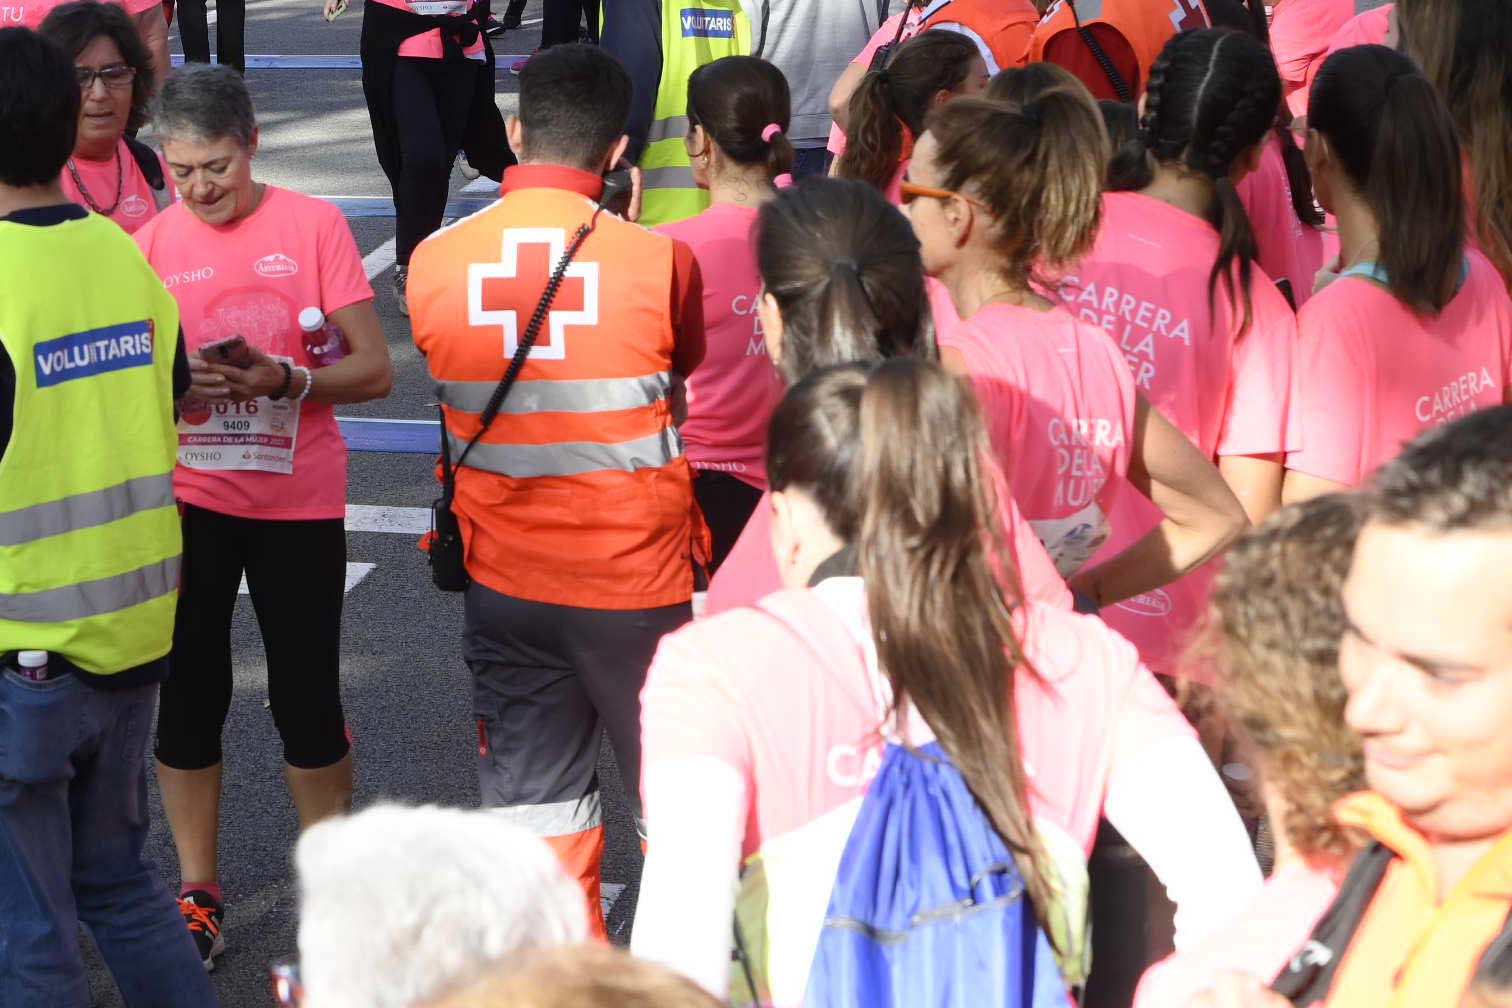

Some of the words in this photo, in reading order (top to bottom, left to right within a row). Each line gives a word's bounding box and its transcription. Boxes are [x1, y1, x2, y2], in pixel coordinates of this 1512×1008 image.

[2, 6, 24, 22] TU
[163, 266, 214, 289] OYSHO
[1058, 274, 1192, 347] CARRERA
[1121, 323, 1156, 361] LA
[1415, 366, 1497, 423] CARRERA
[223, 420, 250, 431] 9409
[185, 451, 222, 462] OYSHO
